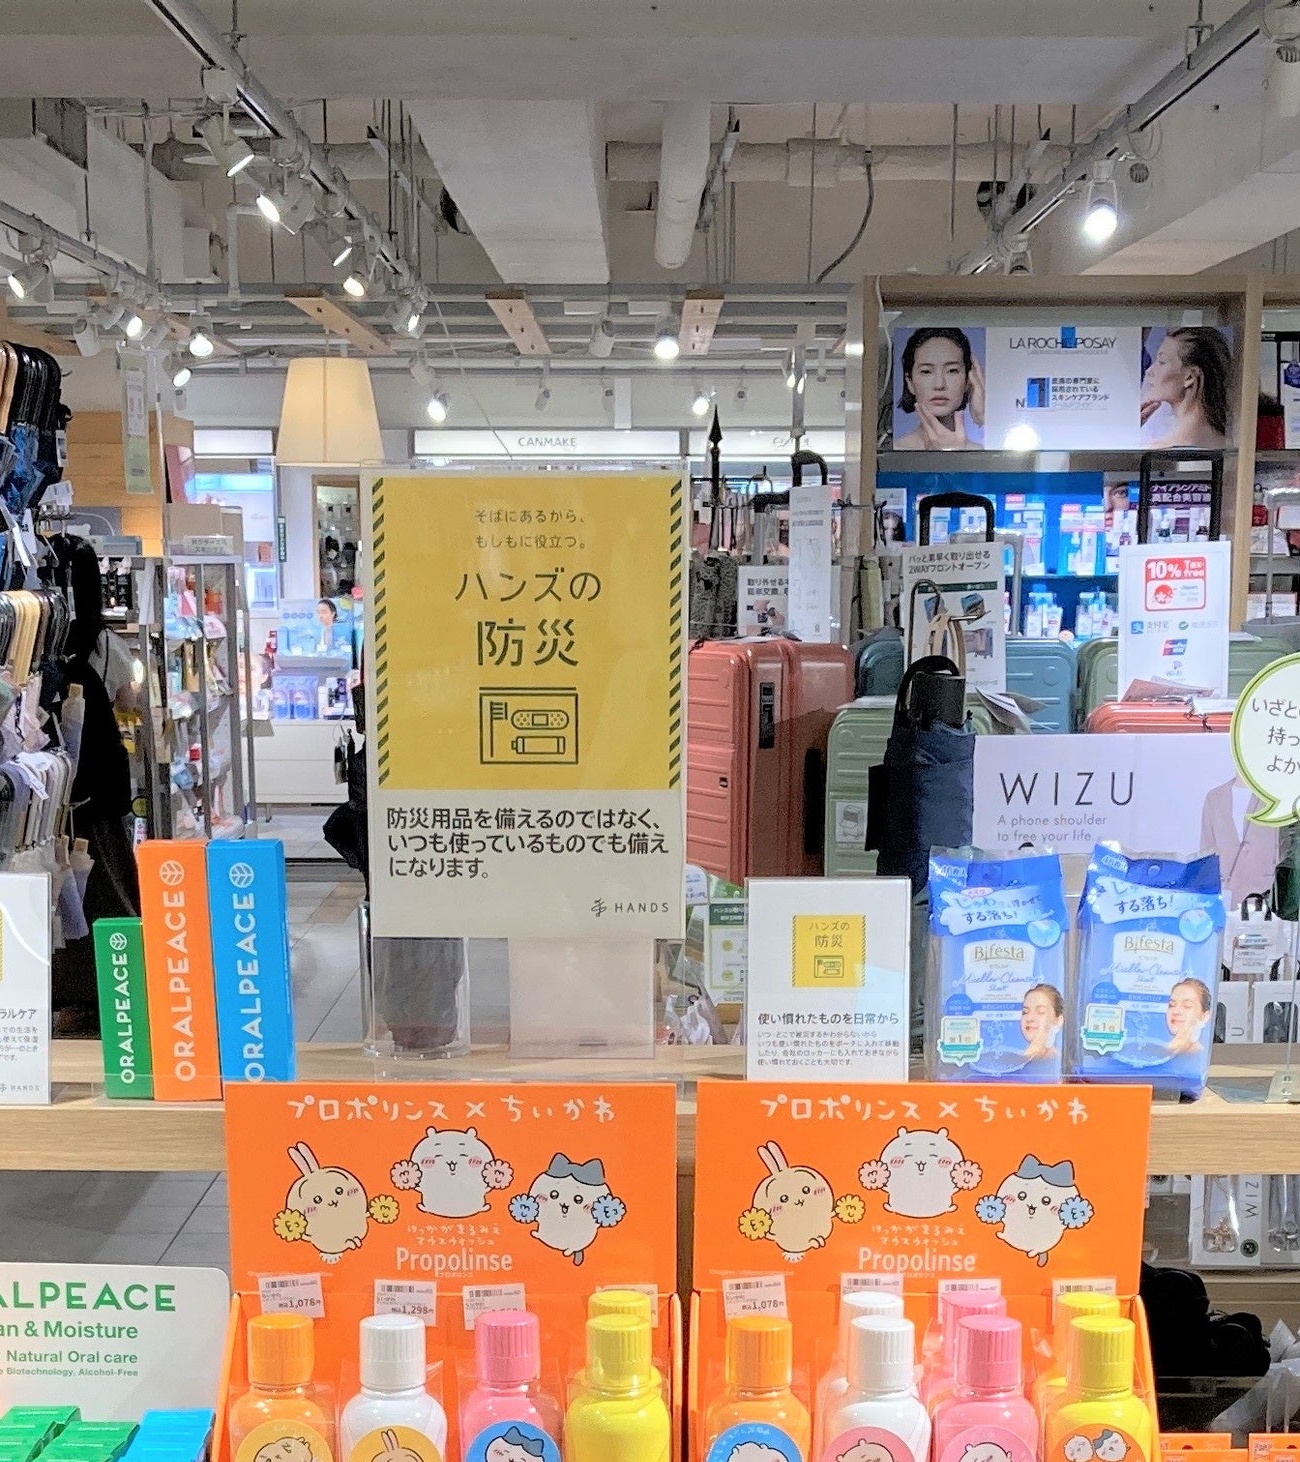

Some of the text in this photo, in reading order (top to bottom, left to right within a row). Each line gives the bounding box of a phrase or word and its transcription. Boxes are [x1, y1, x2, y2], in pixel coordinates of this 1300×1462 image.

[518, 437, 577, 447] CANMAKE
[475, 510, 585, 523] そばにあるから、
[475, 534, 586, 549] もしもに役立つ。
[1147, 562, 1181, 578] 10%
[455, 568, 601, 601] ハンズの
[477, 618, 579, 666] 防災
[1000, 772, 1133, 806] WIZU
[387, 808, 660, 830] 防災用品を備えるのではなく、
[997, 814, 1107, 827] A phone shoulder
[389, 833, 669, 855] いつも使っているものでも備え
[997, 832, 1008, 841] to
[1014, 830, 1037, 841] free
[1042, 833, 1068, 846] your
[390, 858, 489, 878] になります。
[615, 902, 669, 914] HANDS
[810, 922, 849, 931] ハンズの
[815, 935, 843, 947] 防災
[1124, 936, 1174, 952] Bifesta
[974, 946, 1024, 962] Bifesta
[164, 890, 197, 1082] ORALPEACE
[233, 892, 266, 1082] ORALPEACE
[108, 953, 136, 1084] ORALPEACE
[758, 1013, 899, 1024] 使い慣れたものを日常から
[287, 1095, 450, 1122] プロポリンス
[500, 1095, 615, 1123] ちいかわ
[760, 1094, 921, 1122] プロポリンス
[974, 1095, 1089, 1123] ちいかわ
[395, 1247, 513, 1278] Propolinse
[857, 1247, 976, 1277] Propolinse
[25, 1321, 40, 1338] &
[43, 1320, 139, 1340] Moisture
[6, 1350, 63, 1363] Natural
[67, 1350, 100, 1364] Oral
[104, 1352, 139, 1364] care
[79, 1368, 139, 1377] Alcohol-Free
